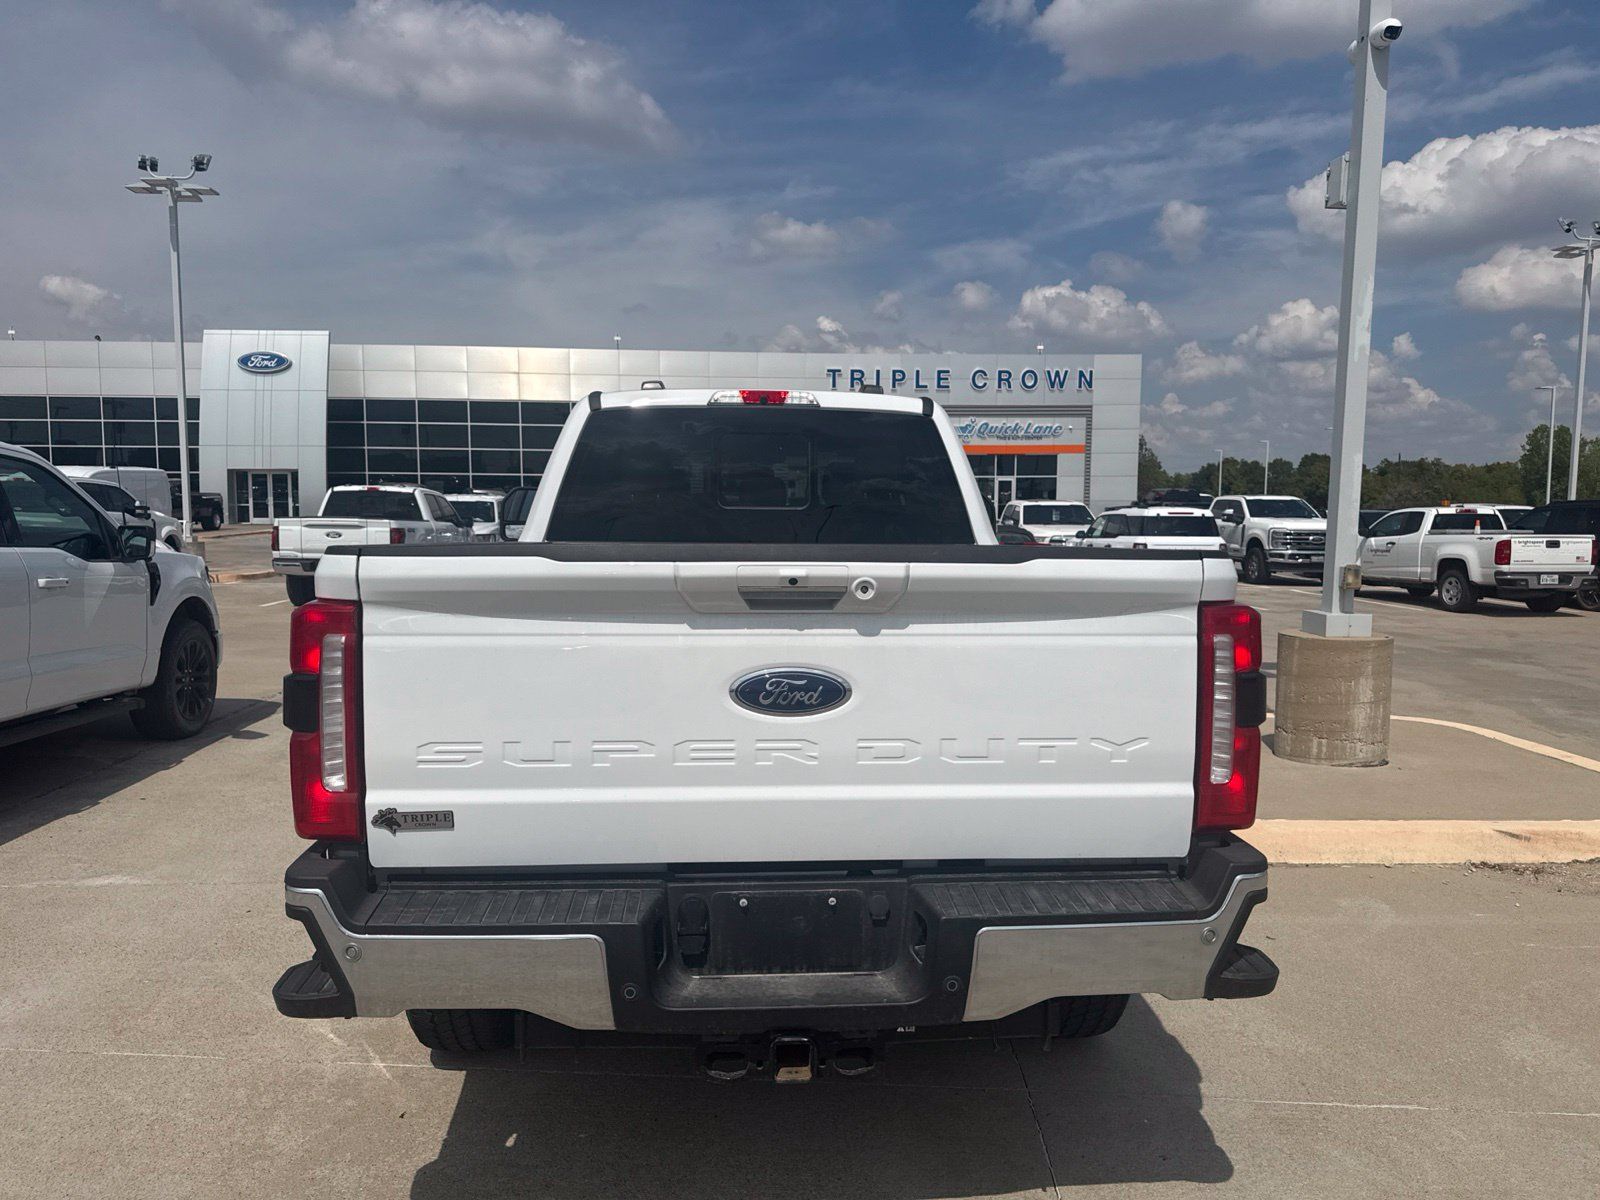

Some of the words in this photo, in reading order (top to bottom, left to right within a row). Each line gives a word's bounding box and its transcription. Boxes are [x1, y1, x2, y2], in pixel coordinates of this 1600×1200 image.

[247, 354, 278, 367] Ford
[827, 368, 951, 390] TRIPLE
[971, 368, 1094, 390] CROWN
[977, 421, 1023, 435] Quick
[1024, 421, 1063, 435] Lane
[758, 678, 823, 705] Ford
[416, 738, 820, 768] SUPER
[856, 736, 1151, 765] DUTY
[402, 813, 451, 823] TRIPLE
